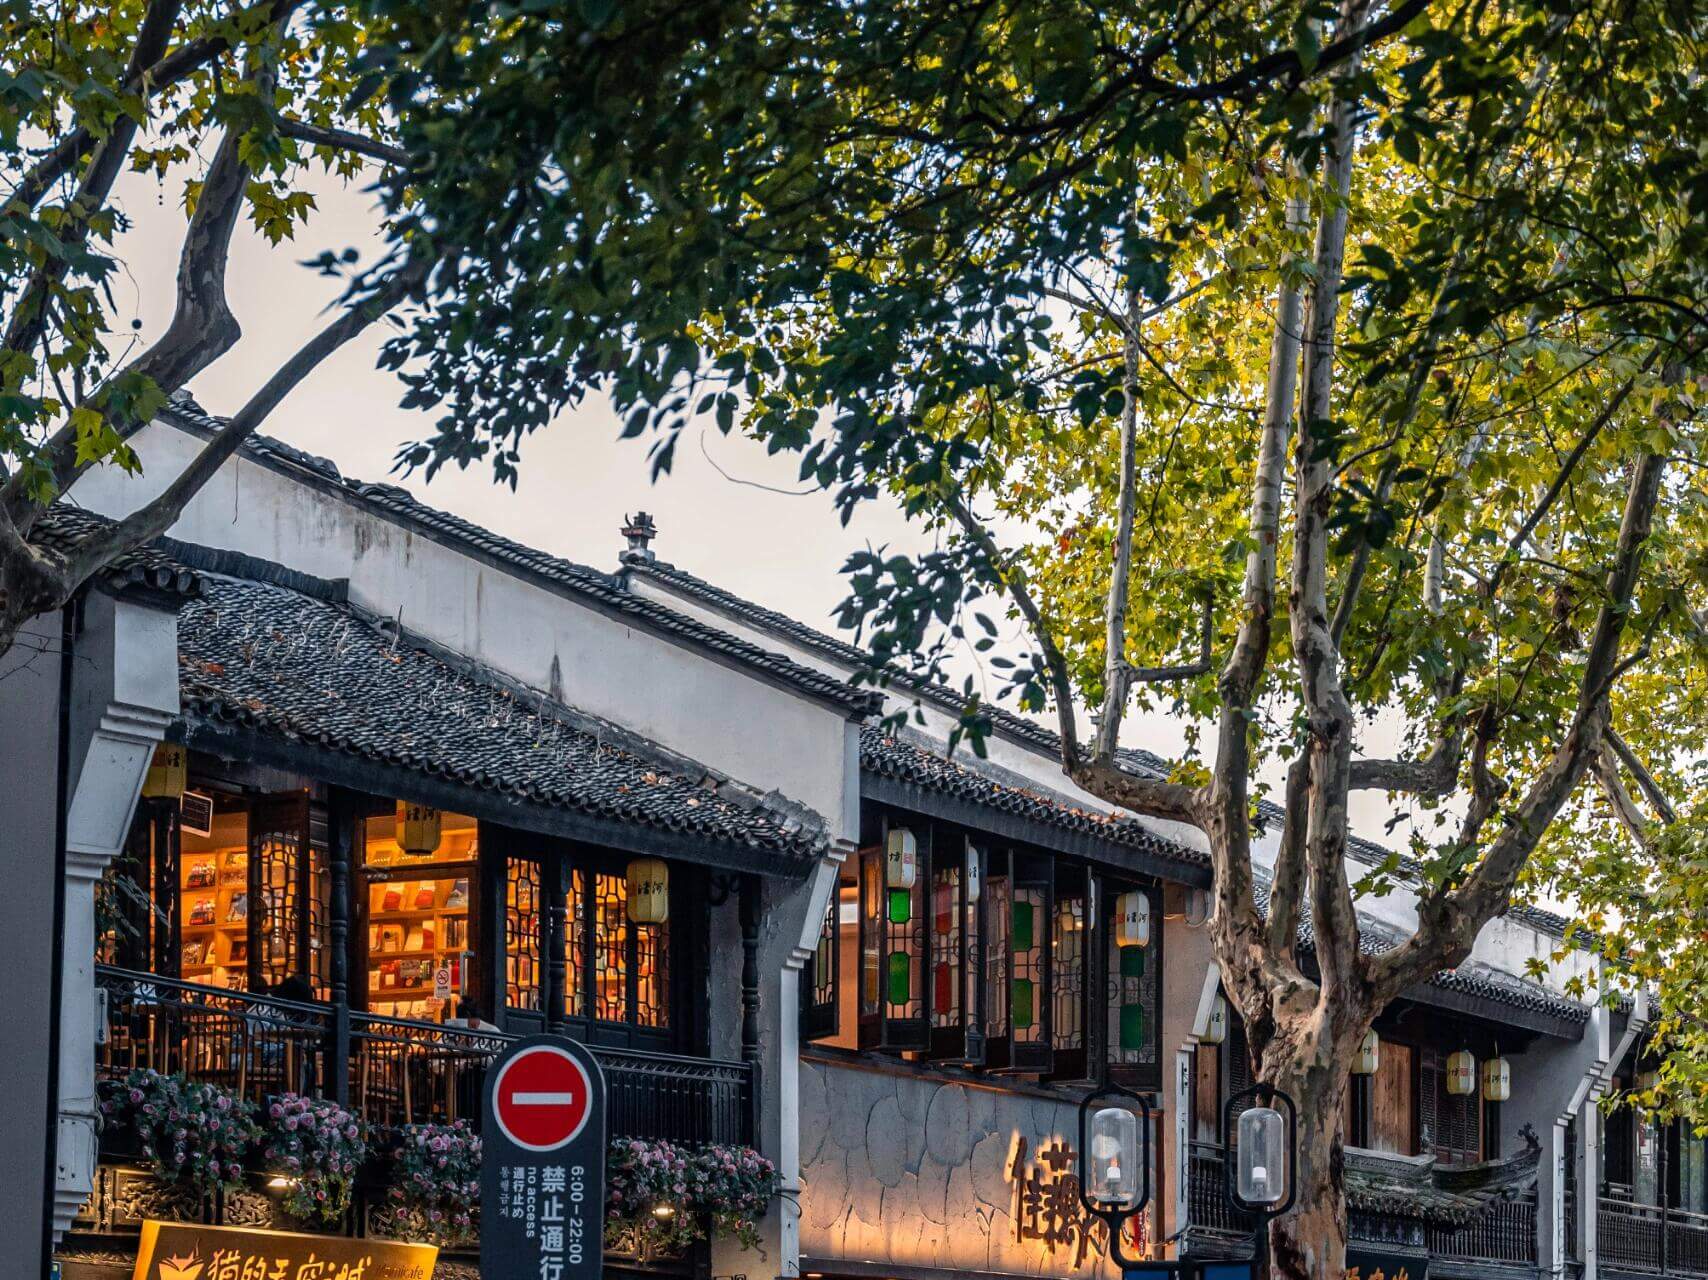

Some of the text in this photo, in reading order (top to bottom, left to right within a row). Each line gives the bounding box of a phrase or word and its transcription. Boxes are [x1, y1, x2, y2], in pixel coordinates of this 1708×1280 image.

[511, 1166, 525, 1219] 通行止め
[526, 1167, 537, 1238] no access
